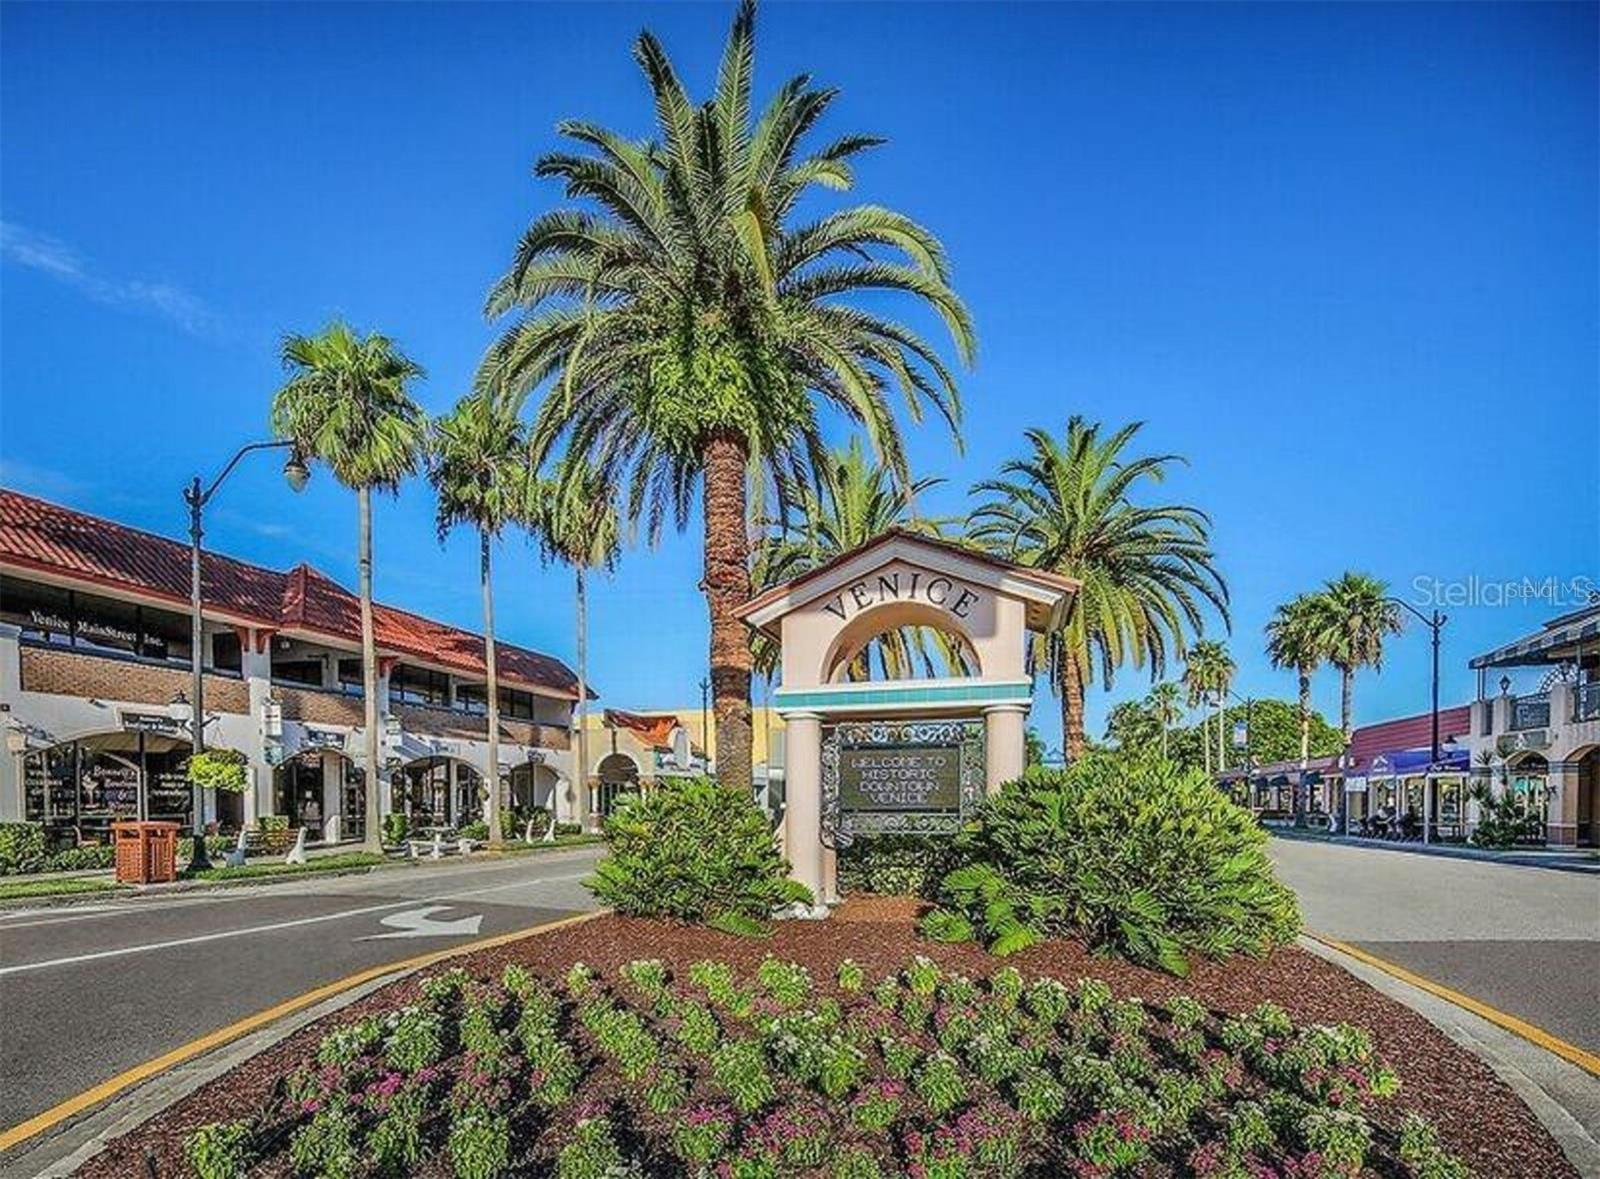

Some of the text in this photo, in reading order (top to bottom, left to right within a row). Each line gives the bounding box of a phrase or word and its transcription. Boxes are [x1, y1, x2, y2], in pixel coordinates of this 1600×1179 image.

[821, 572, 979, 620] VENICE
[30, 610, 70, 629] Venice
[851, 756, 947, 769] WELCOME TO
[861, 768, 937, 780] HISTORIC
[859, 780, 940, 793] DOWNTOWN
[869, 792, 929, 804] VENICE
